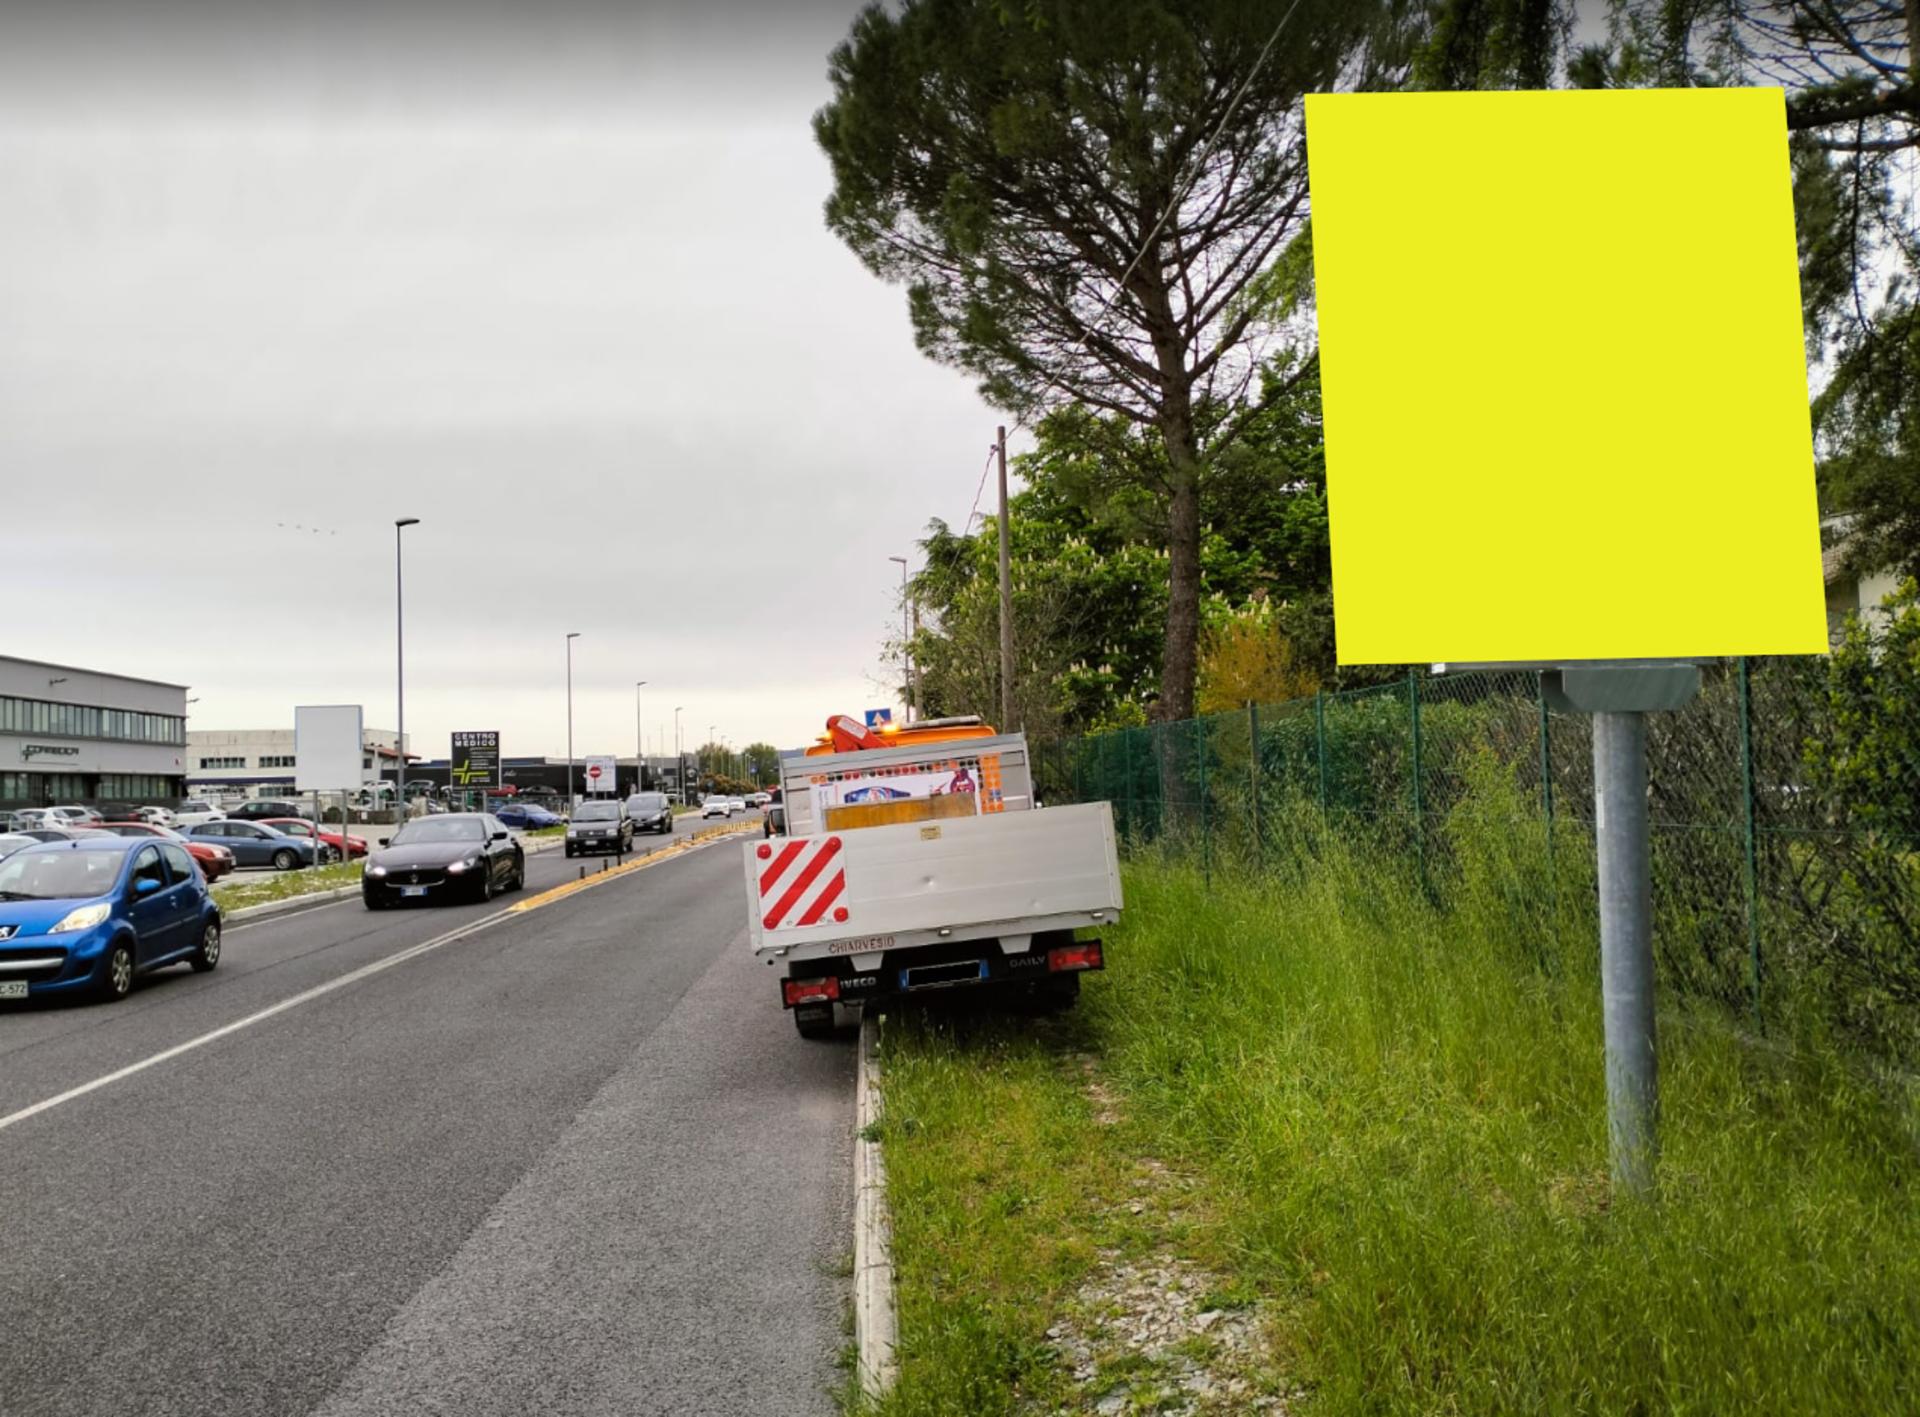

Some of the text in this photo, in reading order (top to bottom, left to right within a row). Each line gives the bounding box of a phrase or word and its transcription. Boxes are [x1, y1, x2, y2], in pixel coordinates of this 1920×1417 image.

[454, 732, 496, 741] CENTRO
[828, 935, 896, 954] CHIARVESIO
[1009, 955, 1046, 968] DAILY
[840, 976, 877, 989] IVECO
